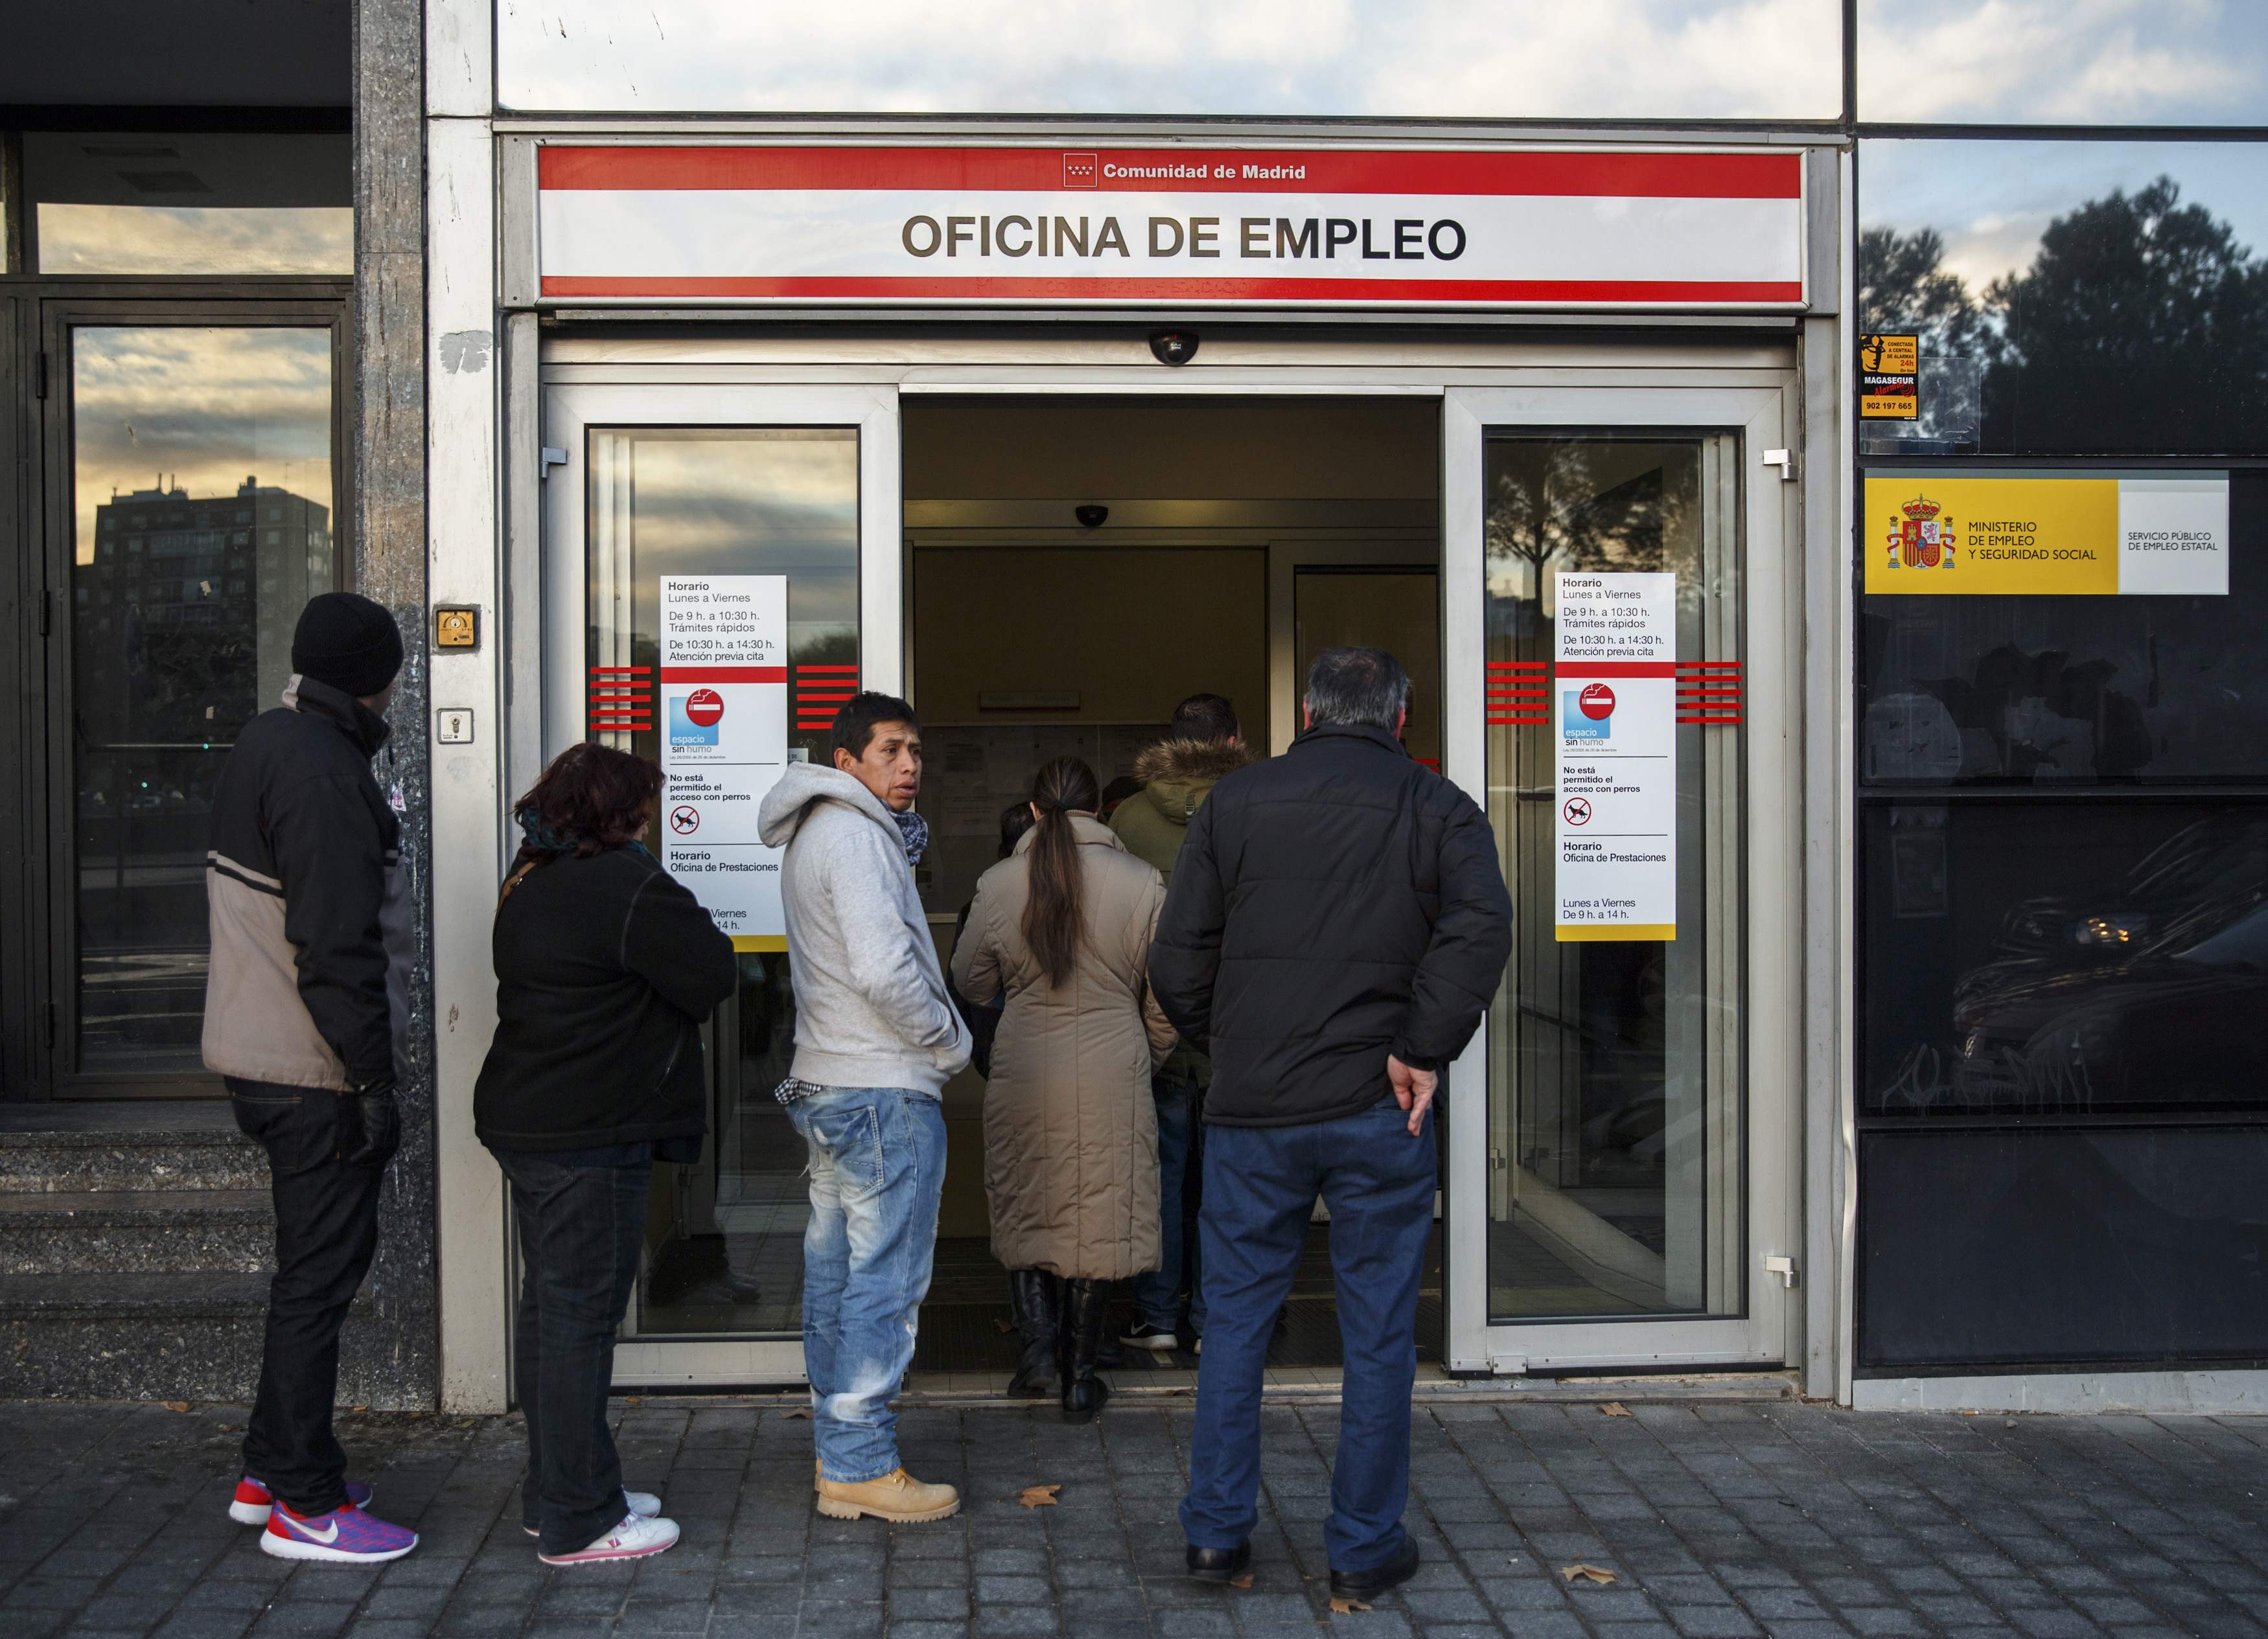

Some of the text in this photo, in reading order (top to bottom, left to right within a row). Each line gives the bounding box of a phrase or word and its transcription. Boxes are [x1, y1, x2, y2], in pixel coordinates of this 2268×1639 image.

[1104, 164, 1305, 179] Comunidad de Madrid
[902, 215, 1466, 260] OFICINA DE EMPLEO
[1969, 522, 2037, 532] MINISTERIO
[2172, 531, 2211, 540] PÚBLICO
[1969, 536, 2034, 545] DE EMPLEO
[1969, 549, 2096, 560] Y SEGURIDAD SOCIAL
[669, 582, 709, 590] Horario
[1564, 579, 1601, 587] Horario
[712, 593, 750, 602] Viernes
[1563, 590, 1592, 599] Lunes
[1604, 590, 1641, 599] Viernes
[670, 612, 683, 620] De
[687, 612, 693, 620] 9
[697, 612, 705, 620] h.
[719, 612, 746, 620] 10:30
[1564, 608, 1577, 616] De
[1580, 608, 1586, 616] 9
[1590, 608, 1597, 616] h.
[1612, 608, 1637, 616] 10:30
[1641, 608, 1649, 616] h.
[669, 623, 755, 634] Trámites rápidos
[1609, 619, 1645, 630] rápidos
[670, 640, 683, 648] De
[687, 640, 713, 648] 10:30
[716, 640, 724, 648] h.
[737, 640, 763, 648] 14:30
[1564, 636, 1577, 644] De
[1580, 636, 1604, 644] 10:30
[1608, 636, 1615, 644] h.
[1628, 636, 1652, 644] 14:30
[1656, 636, 1663, 644] h.
[669, 652, 764, 662] Atención previa cita
[1564, 647, 1654, 658] Atención previa cita
[1566, 729, 1597, 739] espacio
[672, 735, 705, 745] espacio
[1564, 776, 1603, 785] permitido
[670, 784, 712, 792] permitido
[671, 851, 710, 860] Horario
[1597, 853, 1607, 862] de
[1610, 853, 1666, 862] Prestaciones
[671, 863, 778, 871] Oficina de Prestaciones
[1602, 899, 1636, 907] Viernes
[712, 910, 746, 918] Viernes
[1564, 910, 1576, 919] De
[1579, 910, 1584, 919] 9
[1588, 910, 1595, 919] h.
[717, 921, 740, 930] 14 h.
